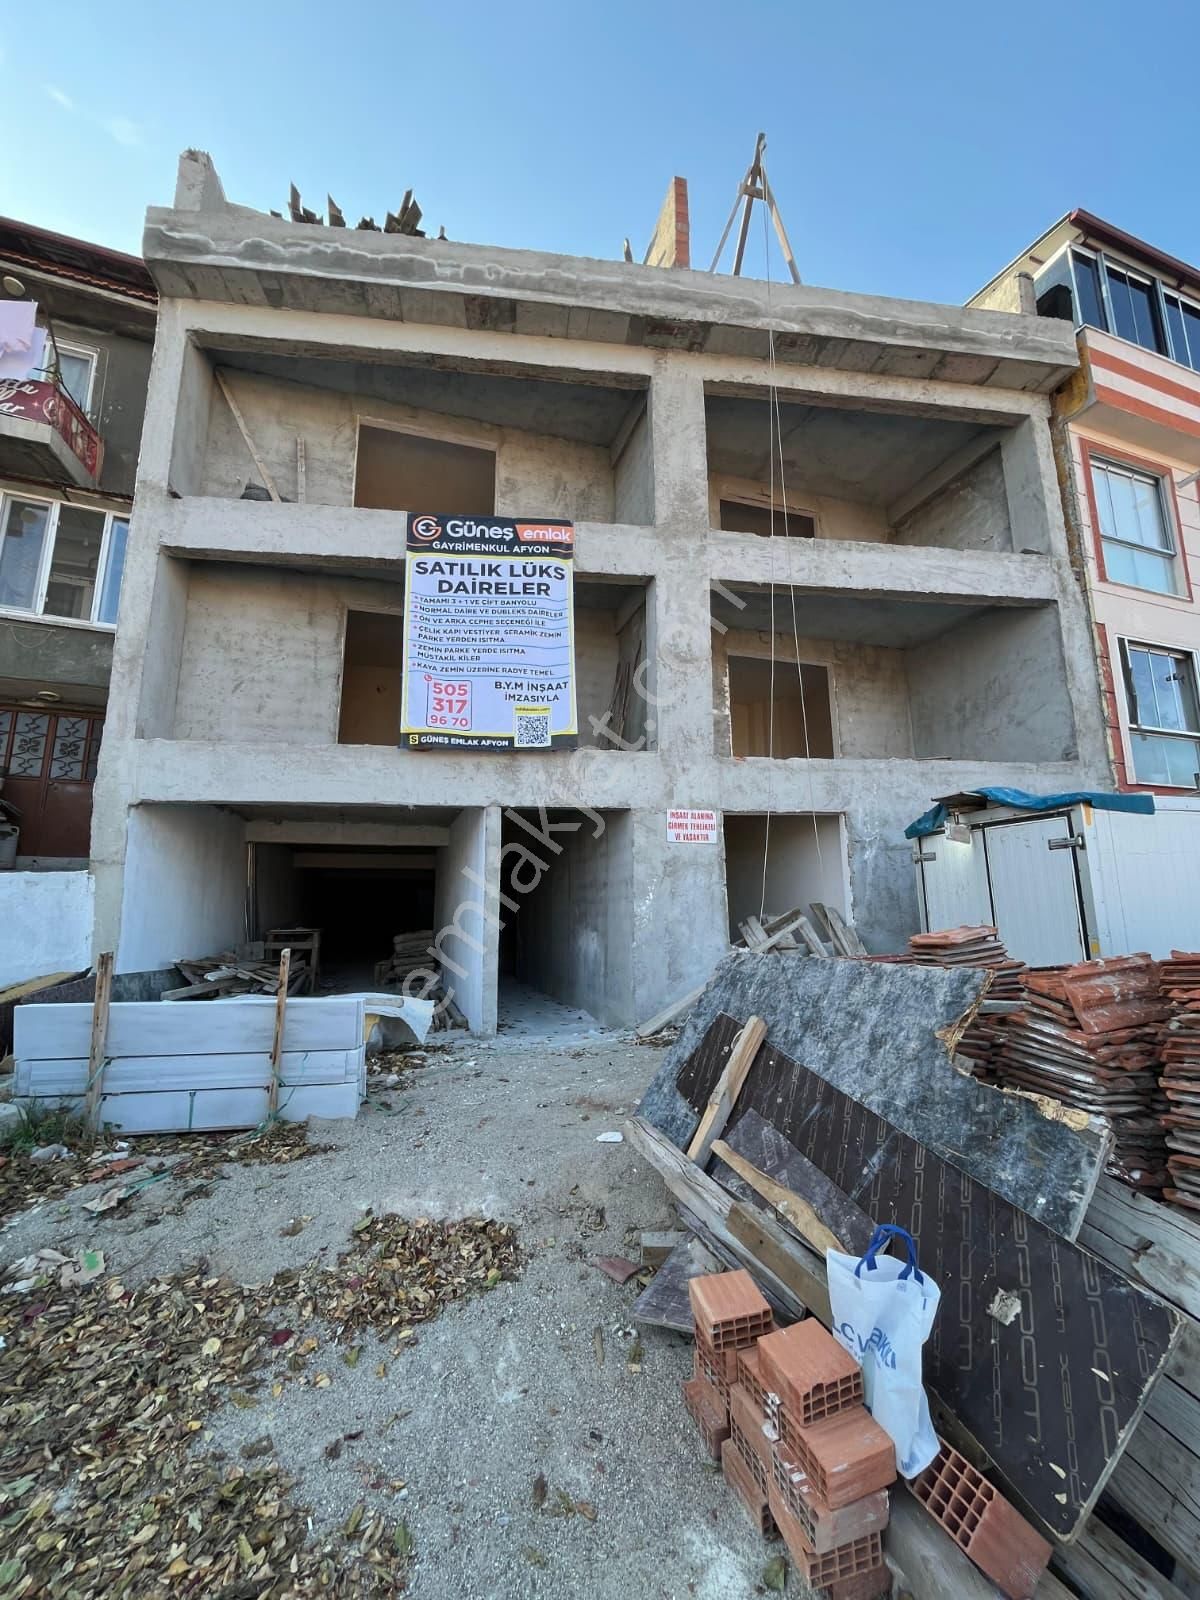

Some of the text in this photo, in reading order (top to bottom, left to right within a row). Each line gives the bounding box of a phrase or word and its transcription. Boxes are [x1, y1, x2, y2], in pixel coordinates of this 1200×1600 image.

[446, 520, 571, 541] Güneş emlak
[432, 541, 550, 554] GAYRİMENKUL AFYON
[415, 561, 566, 580] SATILIK LÜKS
[438, 578, 551, 597] DAİRELER
[419, 606, 453, 614] NORMAL
[418, 633, 444, 643] PARKE
[417, 663, 438, 672] KAYA
[433, 683, 468, 697] 505
[495, 681, 569, 694] B.Y.M İNŞAAT
[505, 693, 560, 703] İMZASIYLA
[432, 698, 468, 714] 317
[430, 715, 468, 728] 96 70
[420, 735, 449, 746] GÜNEŞ
[451, 737, 479, 747] EMLAK
[481, 739, 509, 747] AFYON
[675, 832, 681, 841] VE
